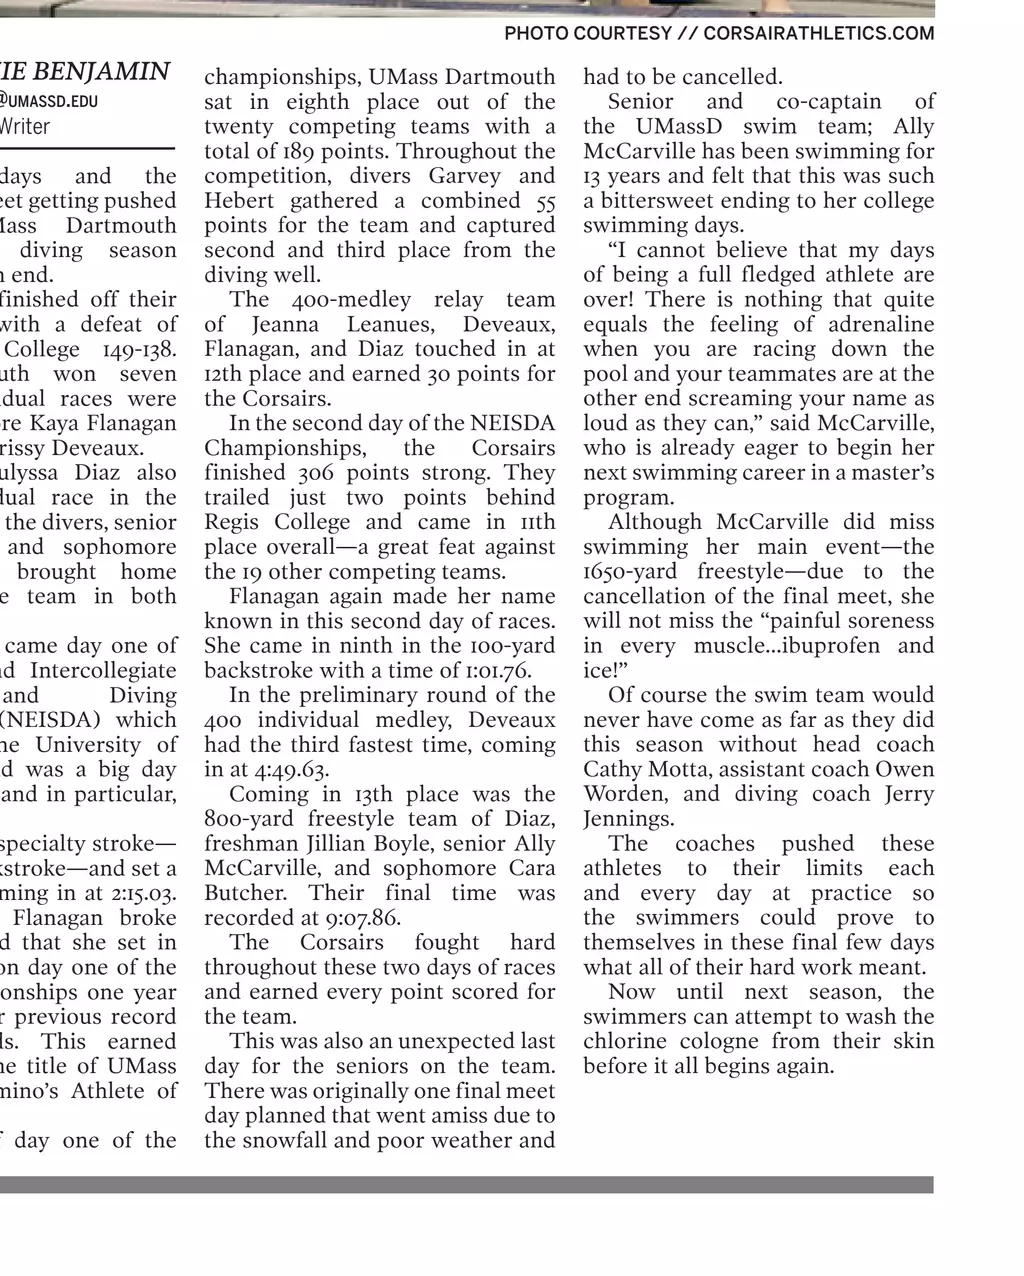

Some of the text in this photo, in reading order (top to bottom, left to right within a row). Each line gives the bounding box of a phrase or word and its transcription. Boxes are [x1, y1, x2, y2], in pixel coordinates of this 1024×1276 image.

[506, 26, 934, 40] PHOTO COURTESY // CORSAIRATHLETICS.COM
[33, 61, 171, 84] BENJAMIN
[205, 67, 555, 89] championships, UMass Dartmouth
[584, 67, 782, 85] had to be cancelled.
[76, 167, 111, 184] and
[146, 167, 176, 184] the
[205, 661, 531, 682] backstroke with a time of 1:01.76.
[584, 1056, 834, 1078] before it all begins again.
